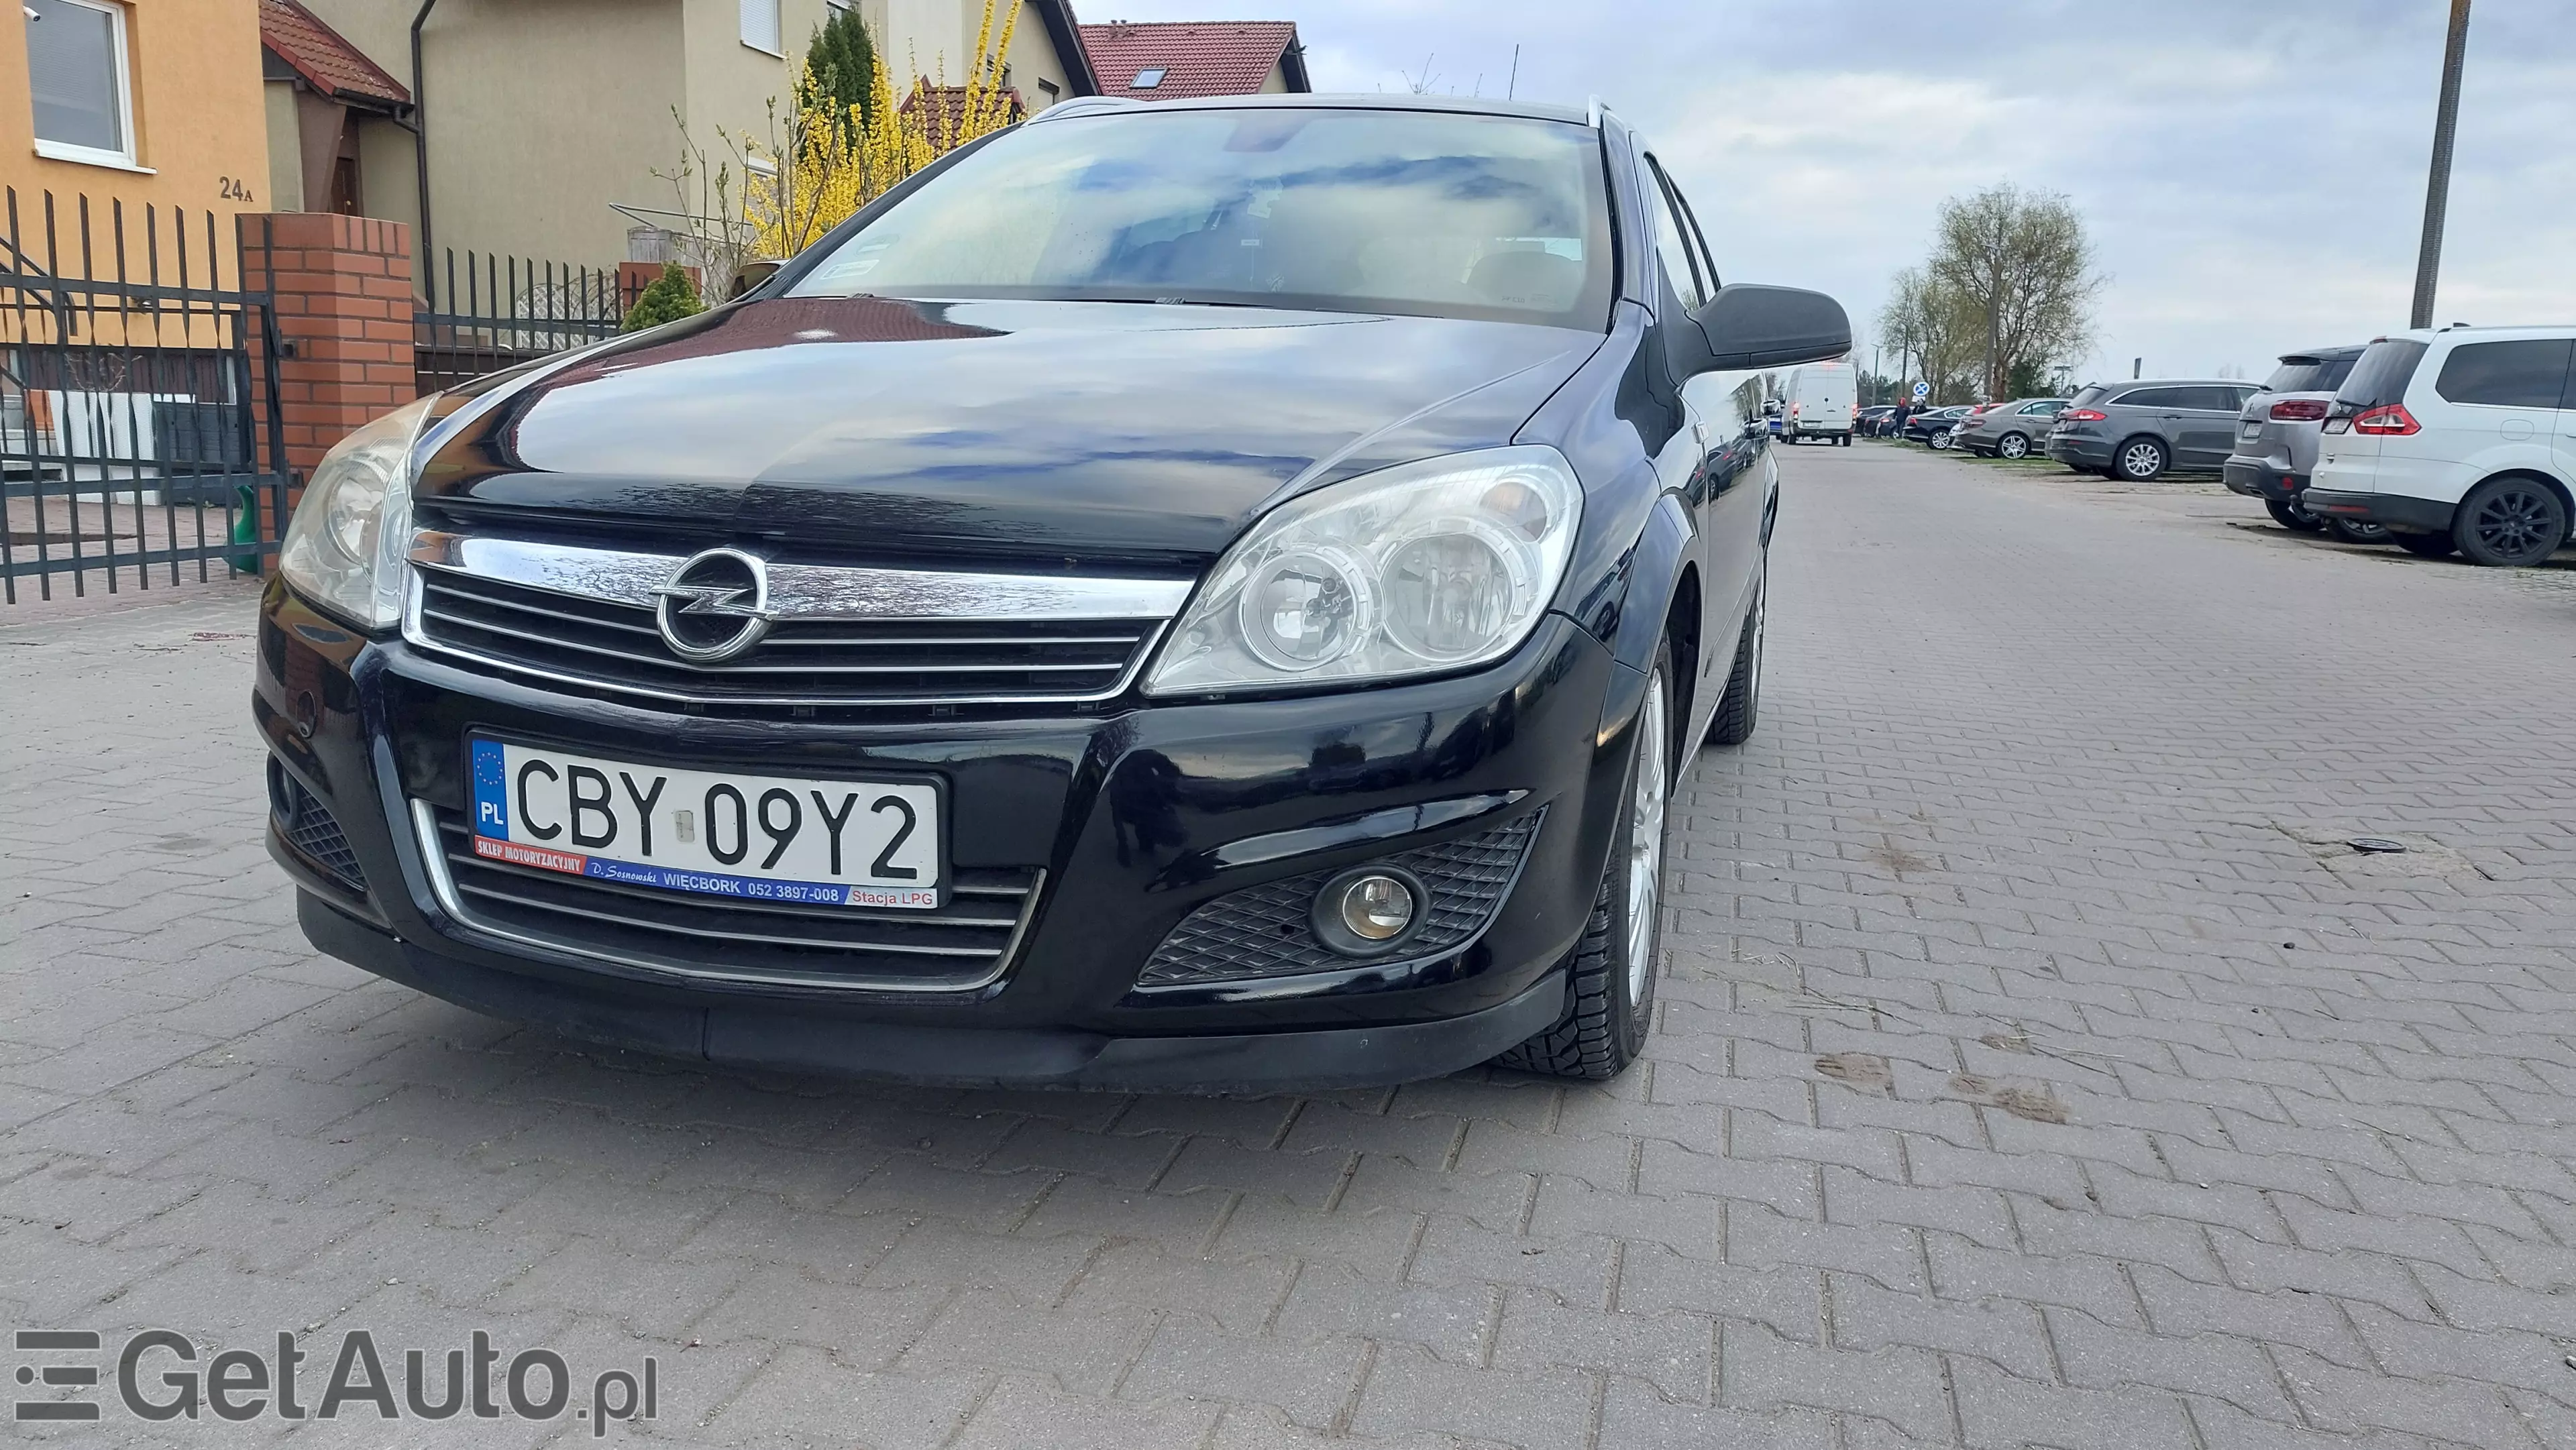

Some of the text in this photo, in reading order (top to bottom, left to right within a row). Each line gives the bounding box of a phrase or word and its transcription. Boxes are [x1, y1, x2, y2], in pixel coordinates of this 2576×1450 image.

[219, 176, 254, 203] 24A
[481, 801, 504, 825] PL
[517, 759, 916, 879] CBY 09Y2
[478, 840, 932, 906] SKLEP MOTORYZACYJNY D. Sosnowski WIĘCBORK 052 3897-008 Stacja LPG
